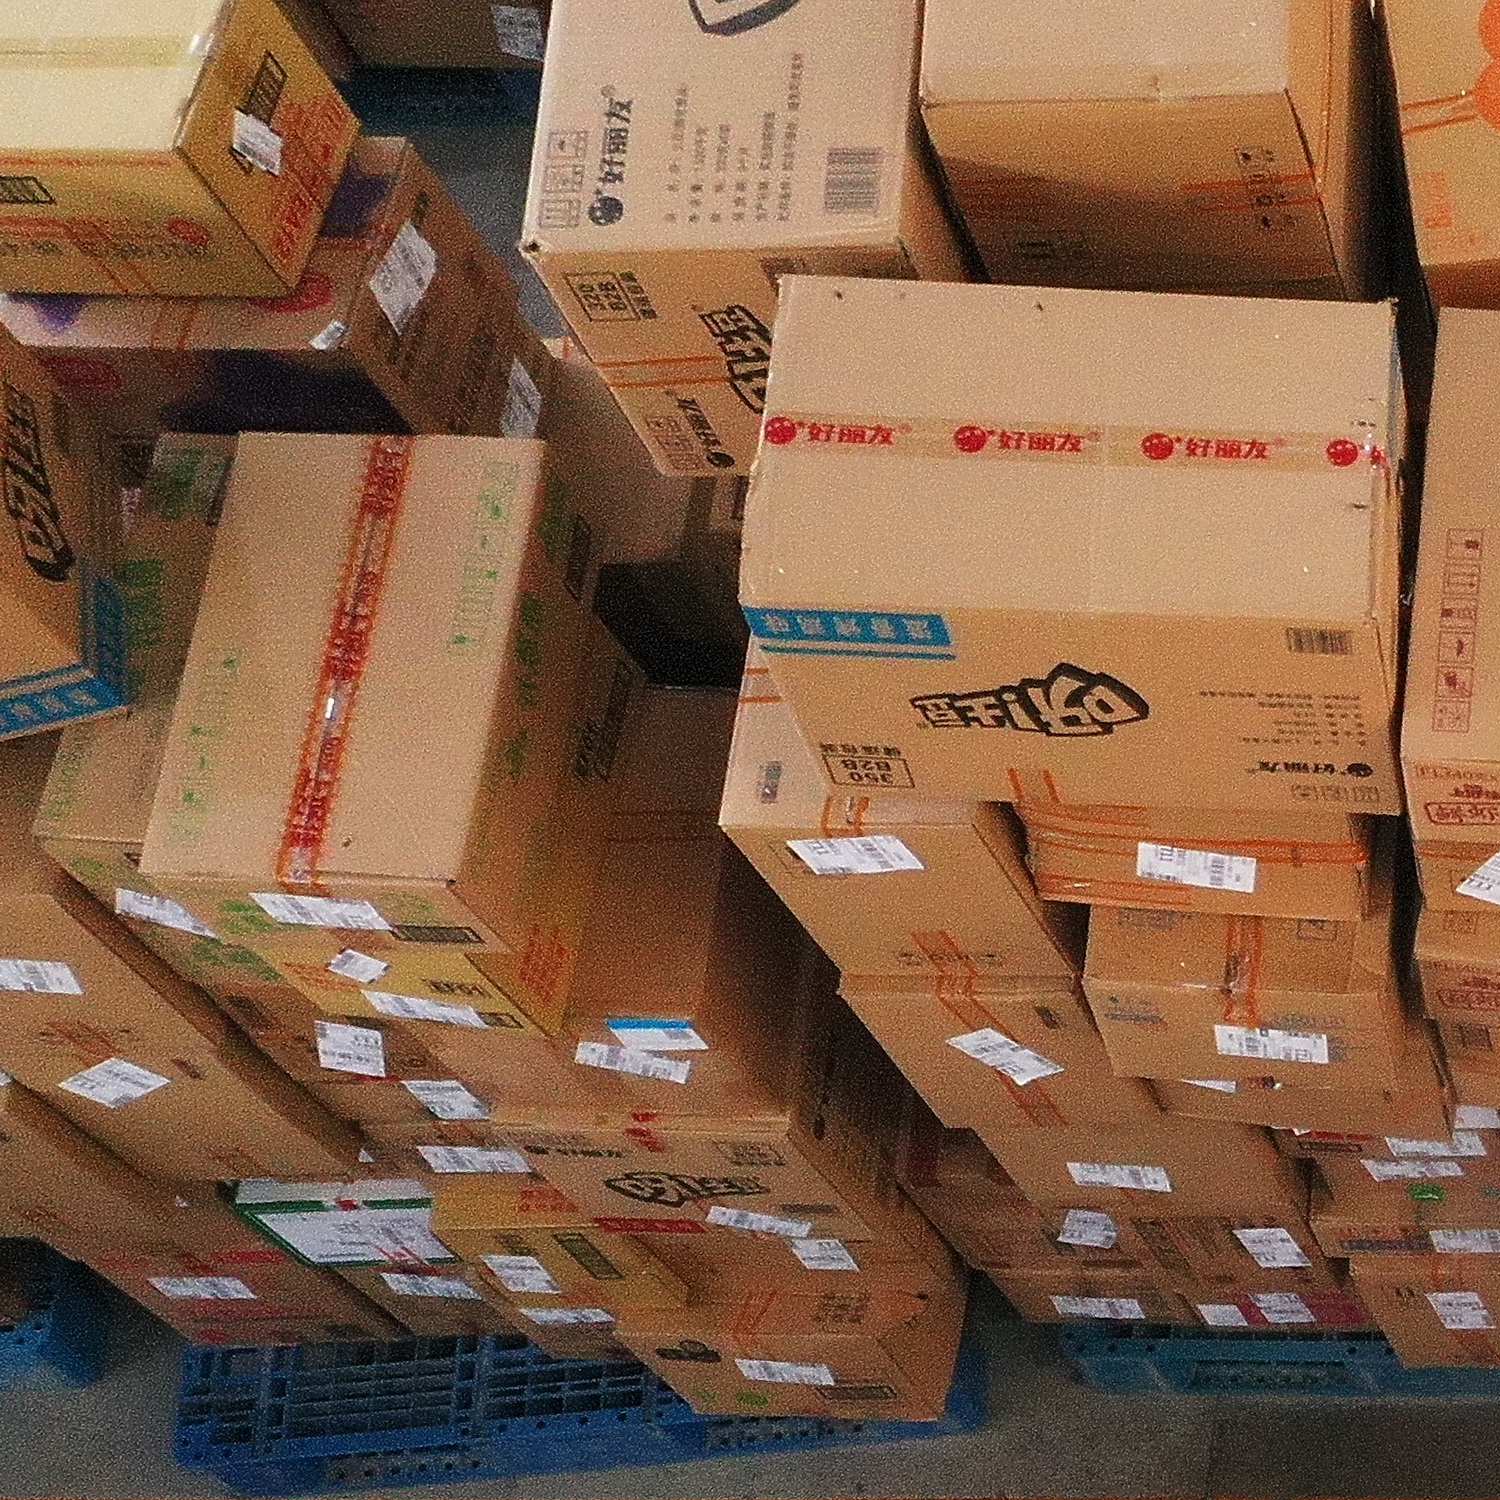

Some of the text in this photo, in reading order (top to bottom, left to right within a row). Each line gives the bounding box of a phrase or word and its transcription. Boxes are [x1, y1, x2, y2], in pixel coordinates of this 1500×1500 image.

[598, 95, 634, 184] 好丽友
[807, 421, 896, 447] 好丽友
[1000, 429, 1084, 454] 好丽友
[1185, 436, 1269, 461] 好丽友
[911, 662, 1150, 738] 呀!土豆
